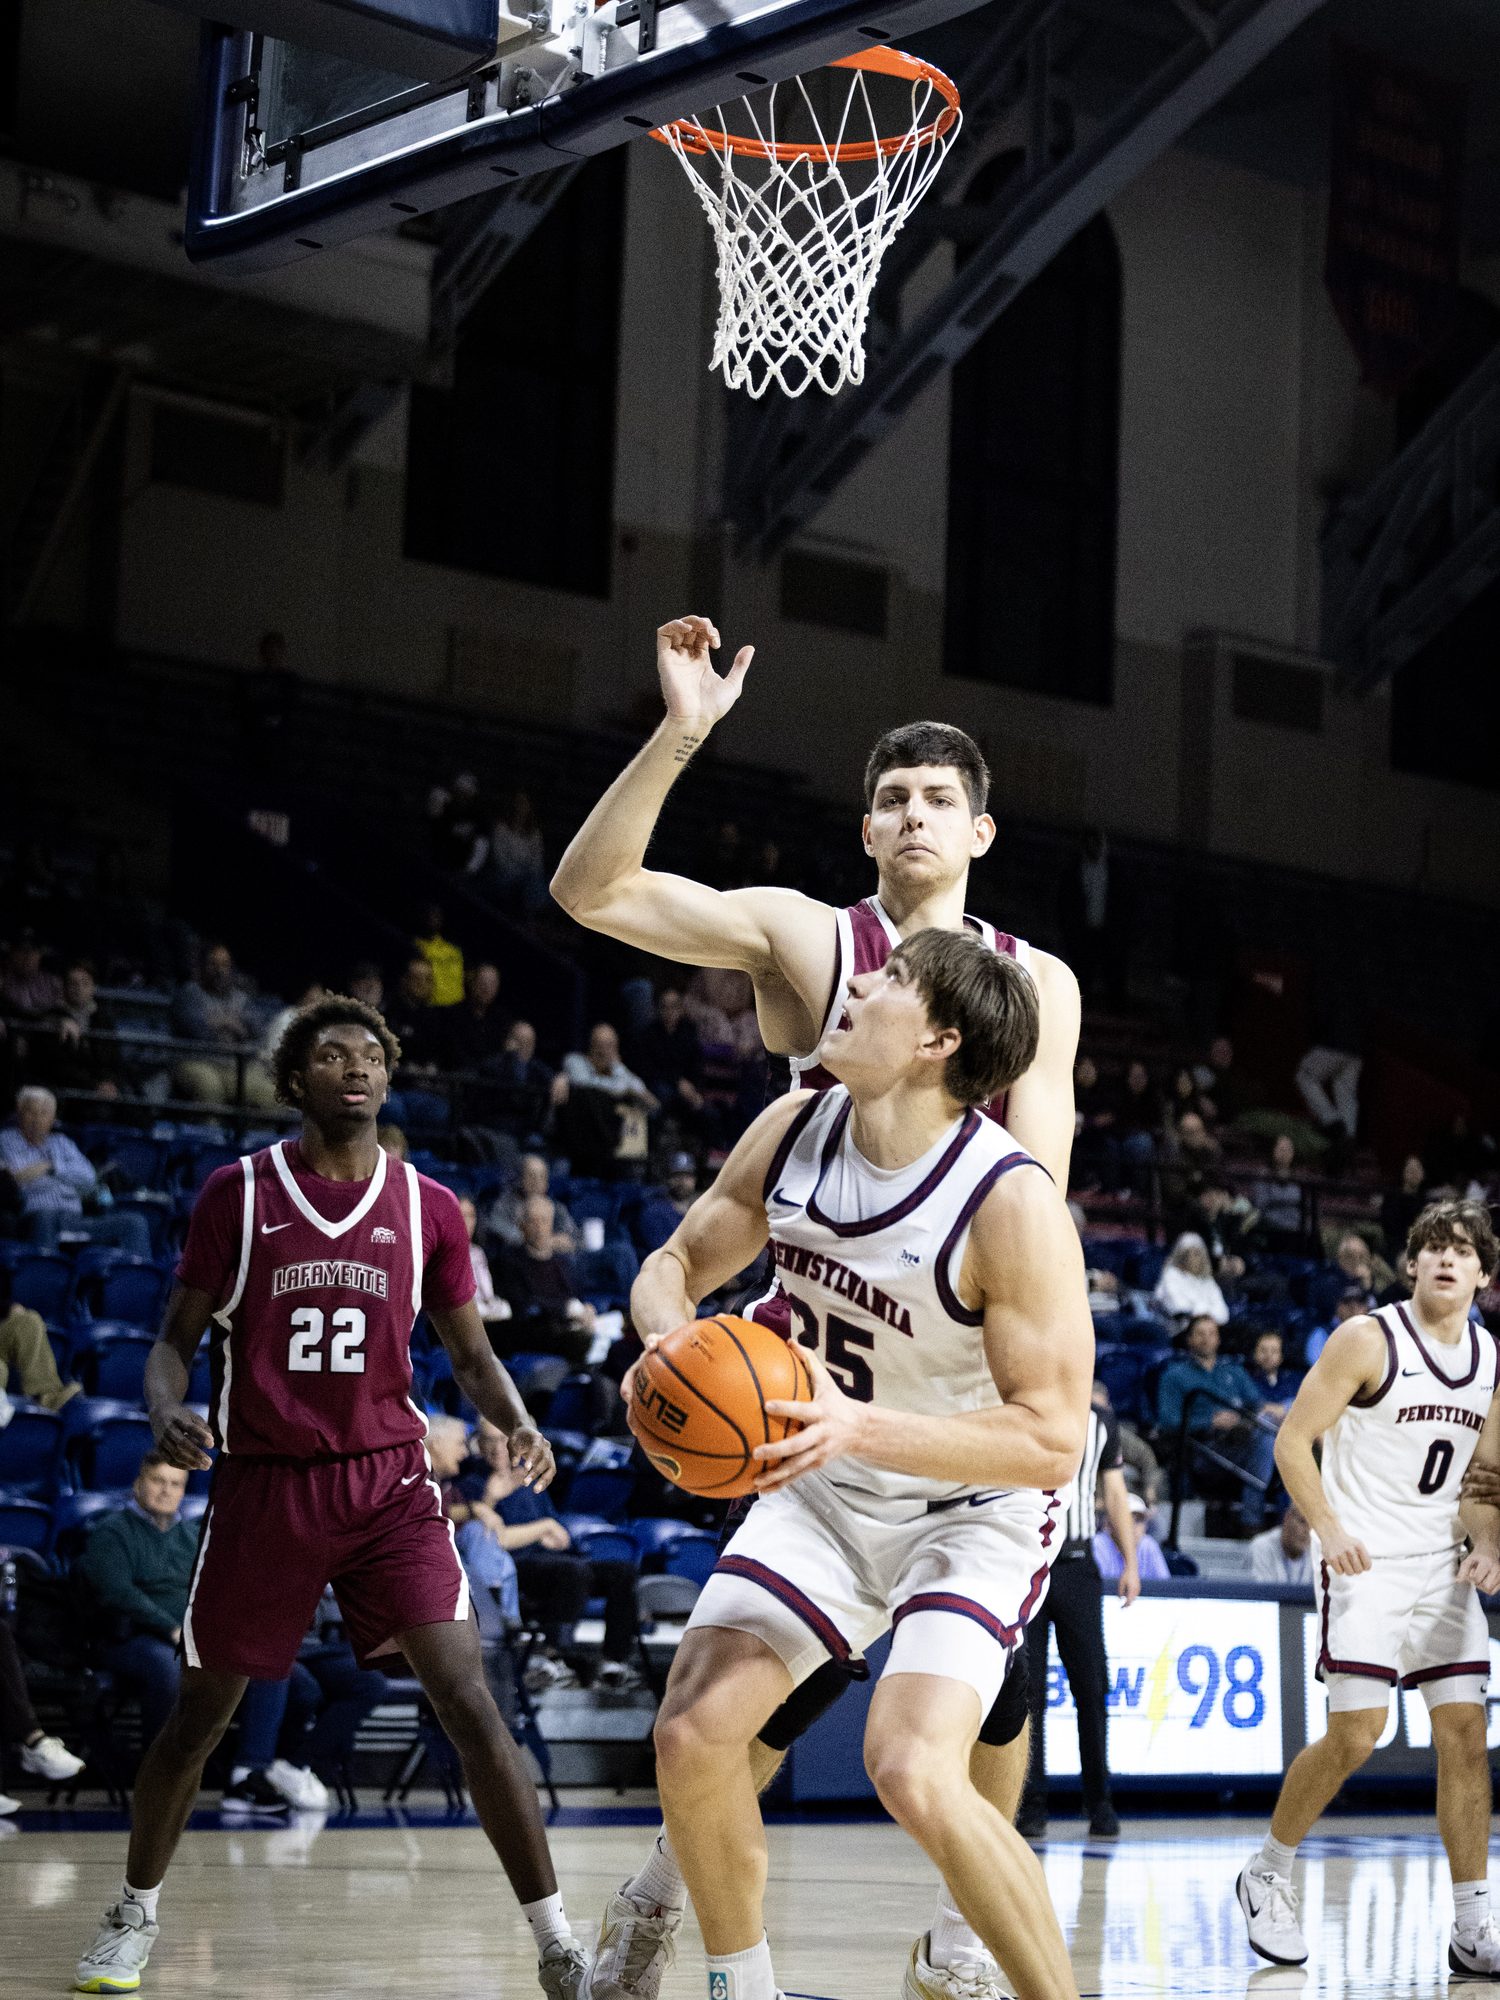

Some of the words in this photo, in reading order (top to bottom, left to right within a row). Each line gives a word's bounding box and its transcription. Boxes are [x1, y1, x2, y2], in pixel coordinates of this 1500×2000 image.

[272, 1260, 388, 1301] LAFAYETTE
[288, 1307, 366, 1373] 22
[1418, 1438, 1455, 1495] 0
[1177, 1645, 1266, 1729] 98
